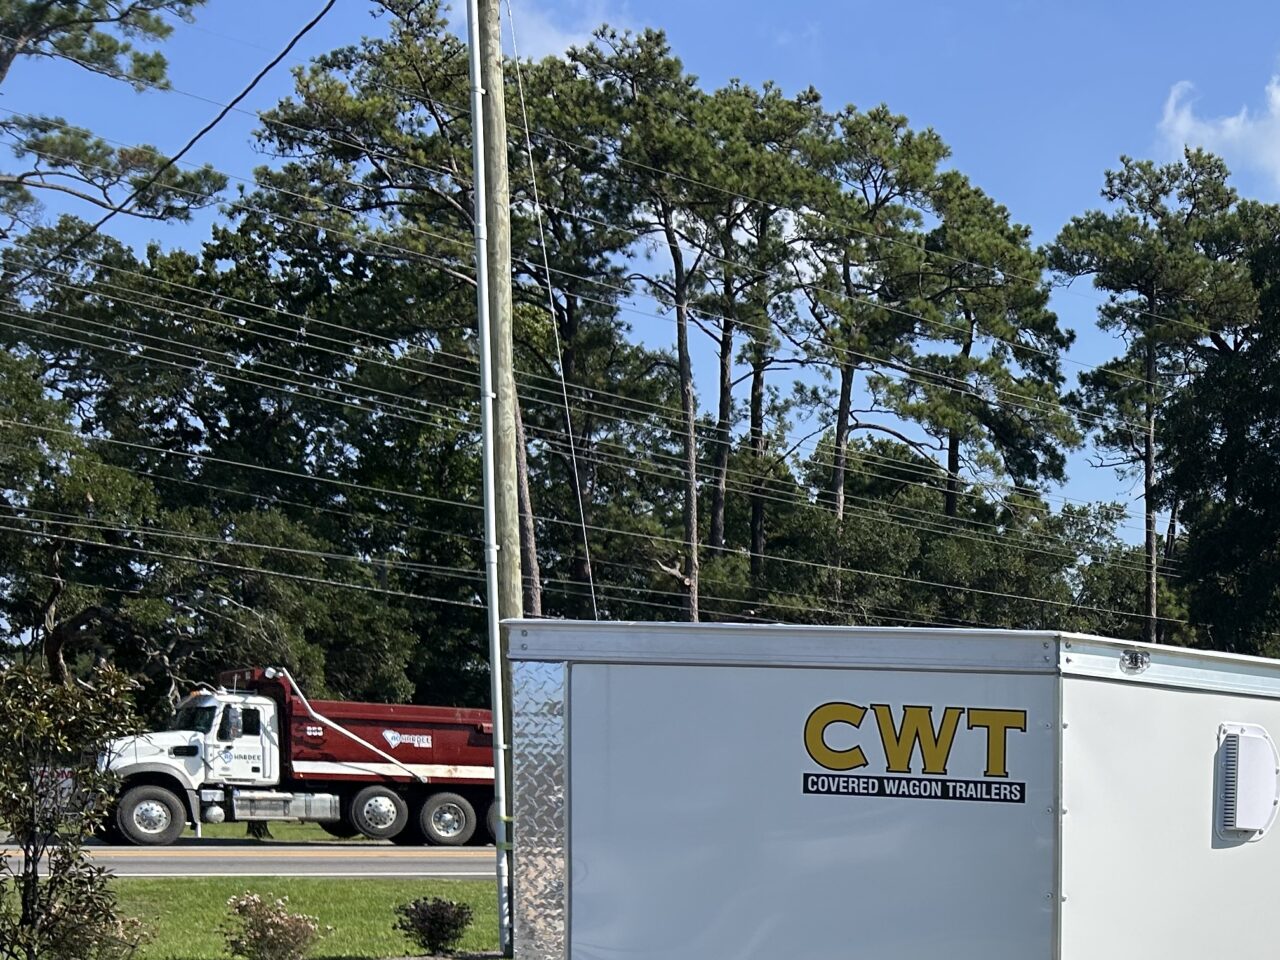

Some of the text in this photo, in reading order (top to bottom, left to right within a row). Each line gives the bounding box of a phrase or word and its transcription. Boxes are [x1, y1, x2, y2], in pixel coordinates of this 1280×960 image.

[803, 701, 1027, 778] CWT
[807, 775, 1021, 800] COVERED WAGON TRAILERS
